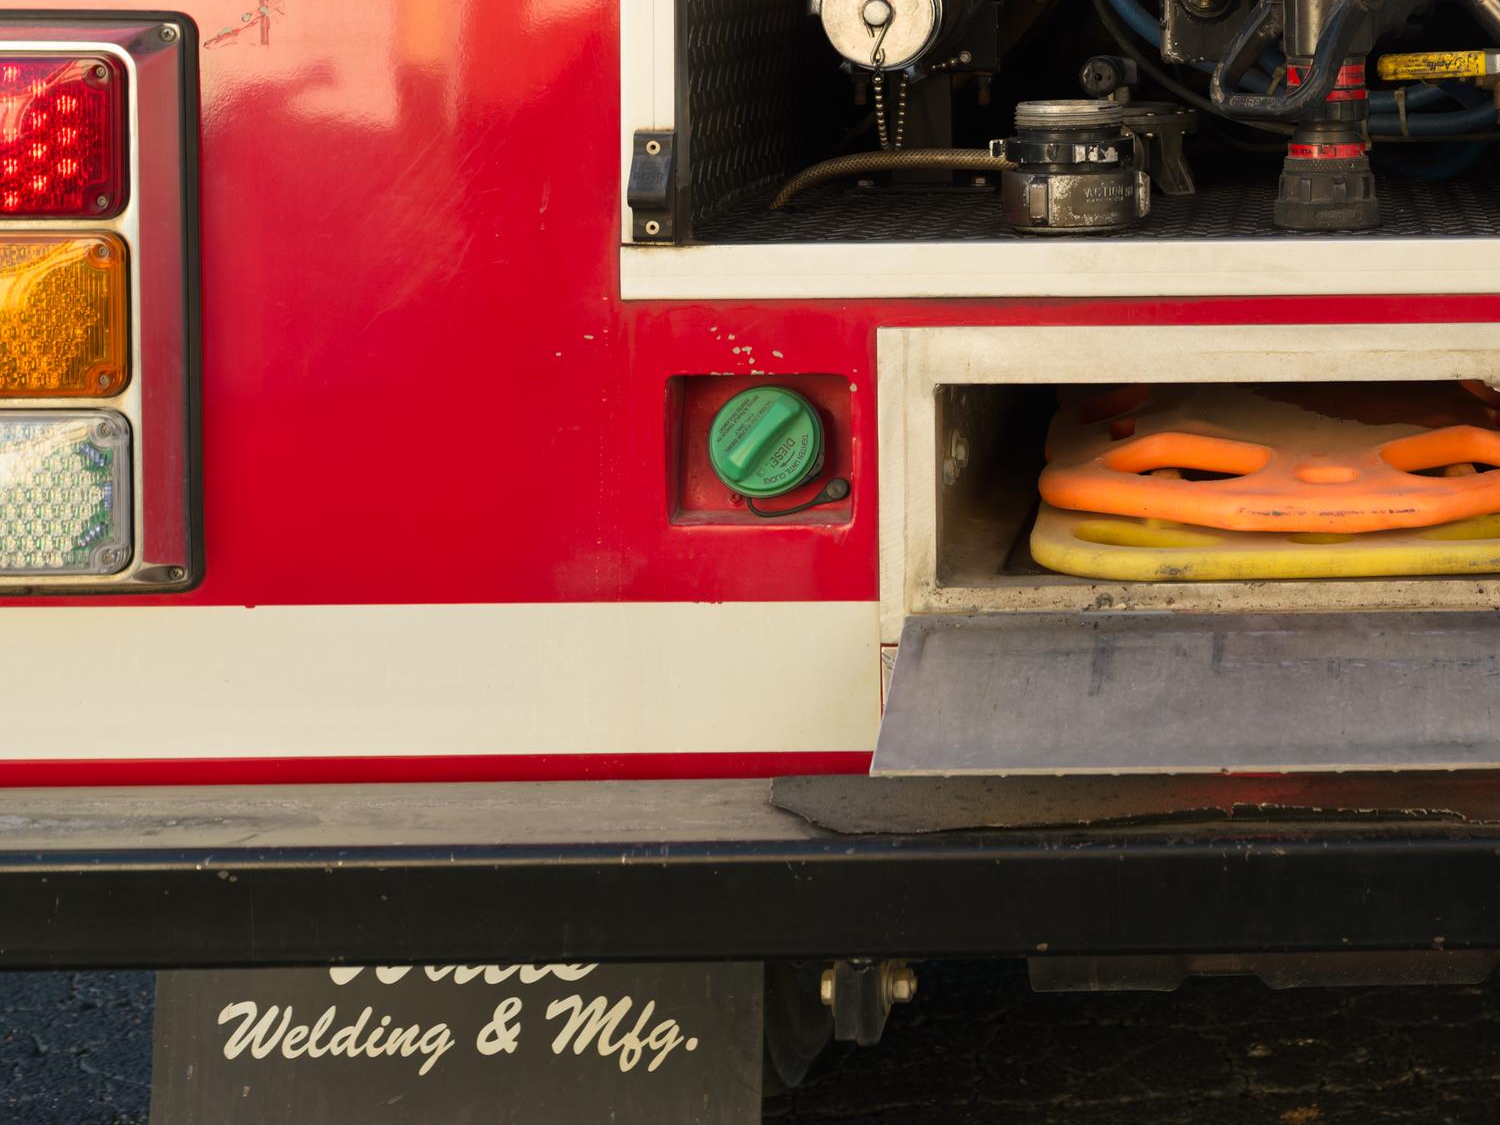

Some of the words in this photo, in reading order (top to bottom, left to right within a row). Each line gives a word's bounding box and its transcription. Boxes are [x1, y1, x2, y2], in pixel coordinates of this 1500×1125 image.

[763, 473, 786, 485] CLICKS
[217, 999, 455, 1076] Welding
[475, 996, 522, 1055] &
[545, 993, 699, 1073] Mfg.
